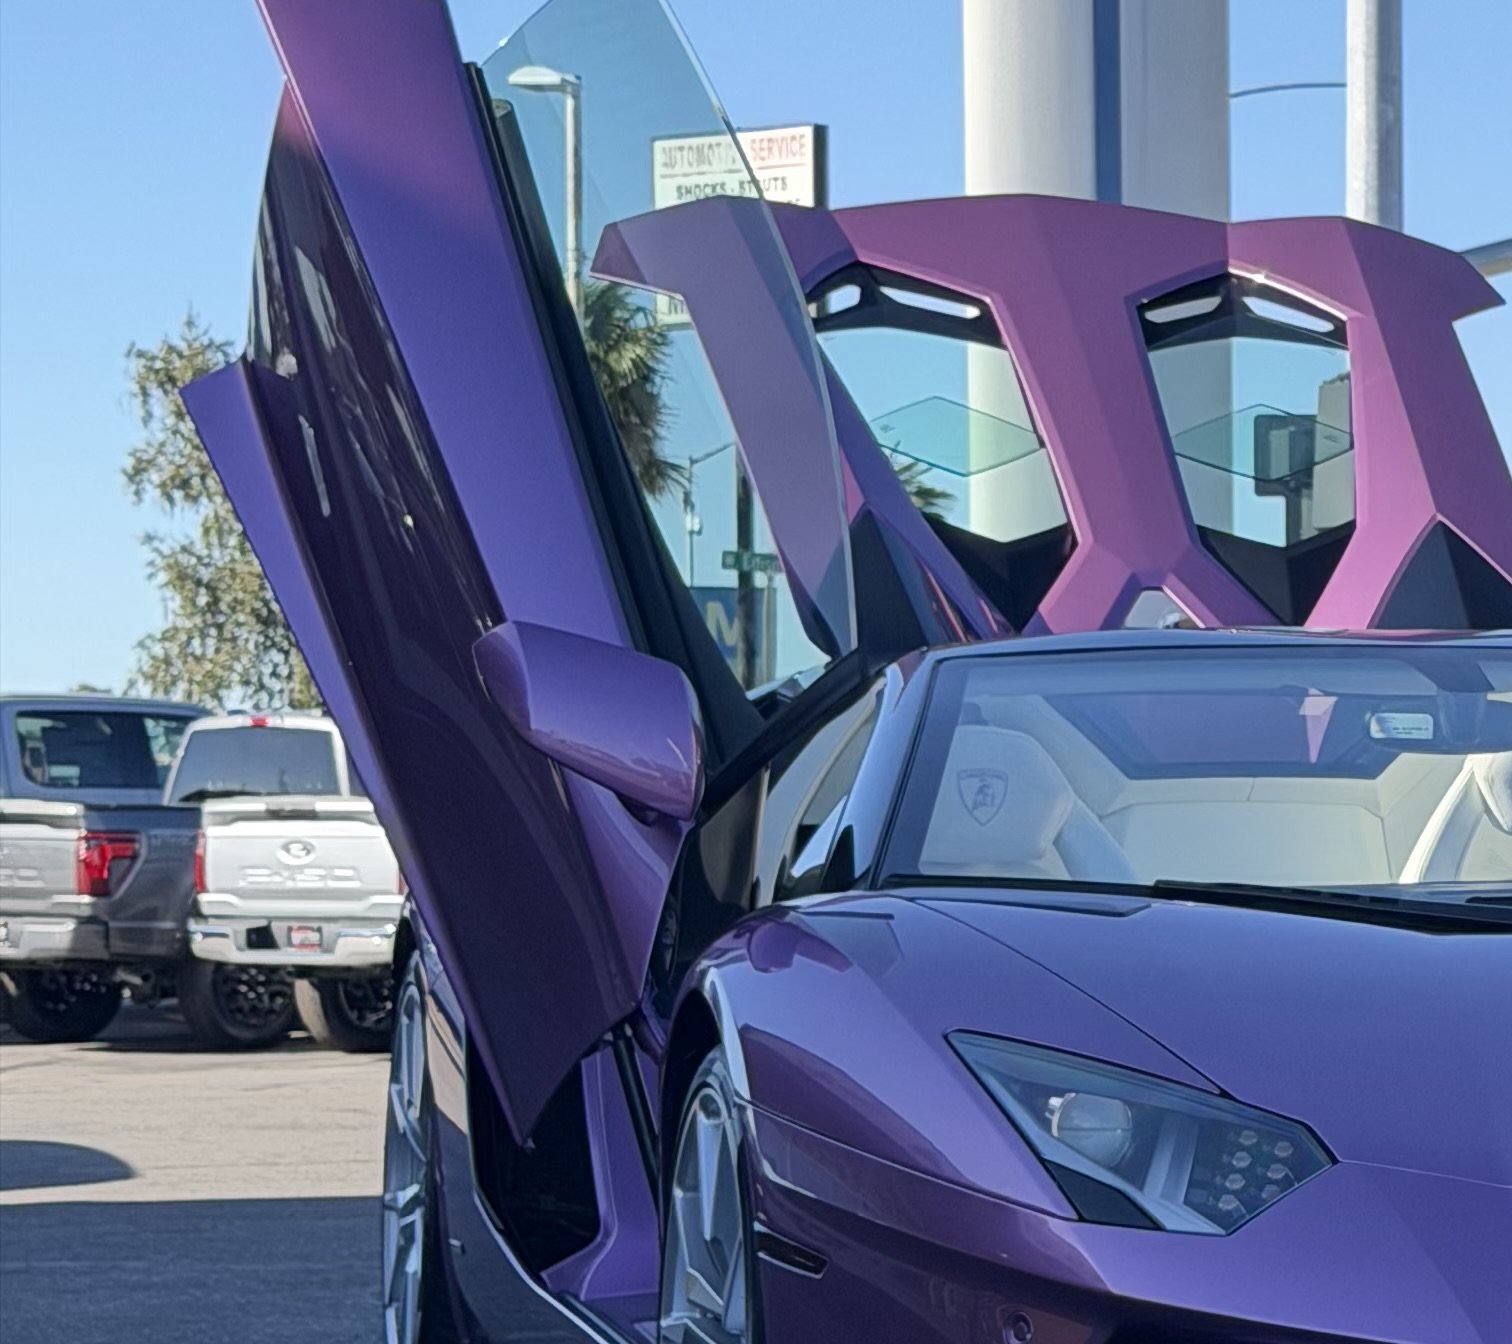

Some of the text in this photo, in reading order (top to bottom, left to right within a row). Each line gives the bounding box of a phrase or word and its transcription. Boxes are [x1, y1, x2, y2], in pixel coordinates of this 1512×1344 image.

[660, 133, 807, 171] AUTOMOTIV SERVICE
[675, 175, 789, 201] SHOCKS STUTS
